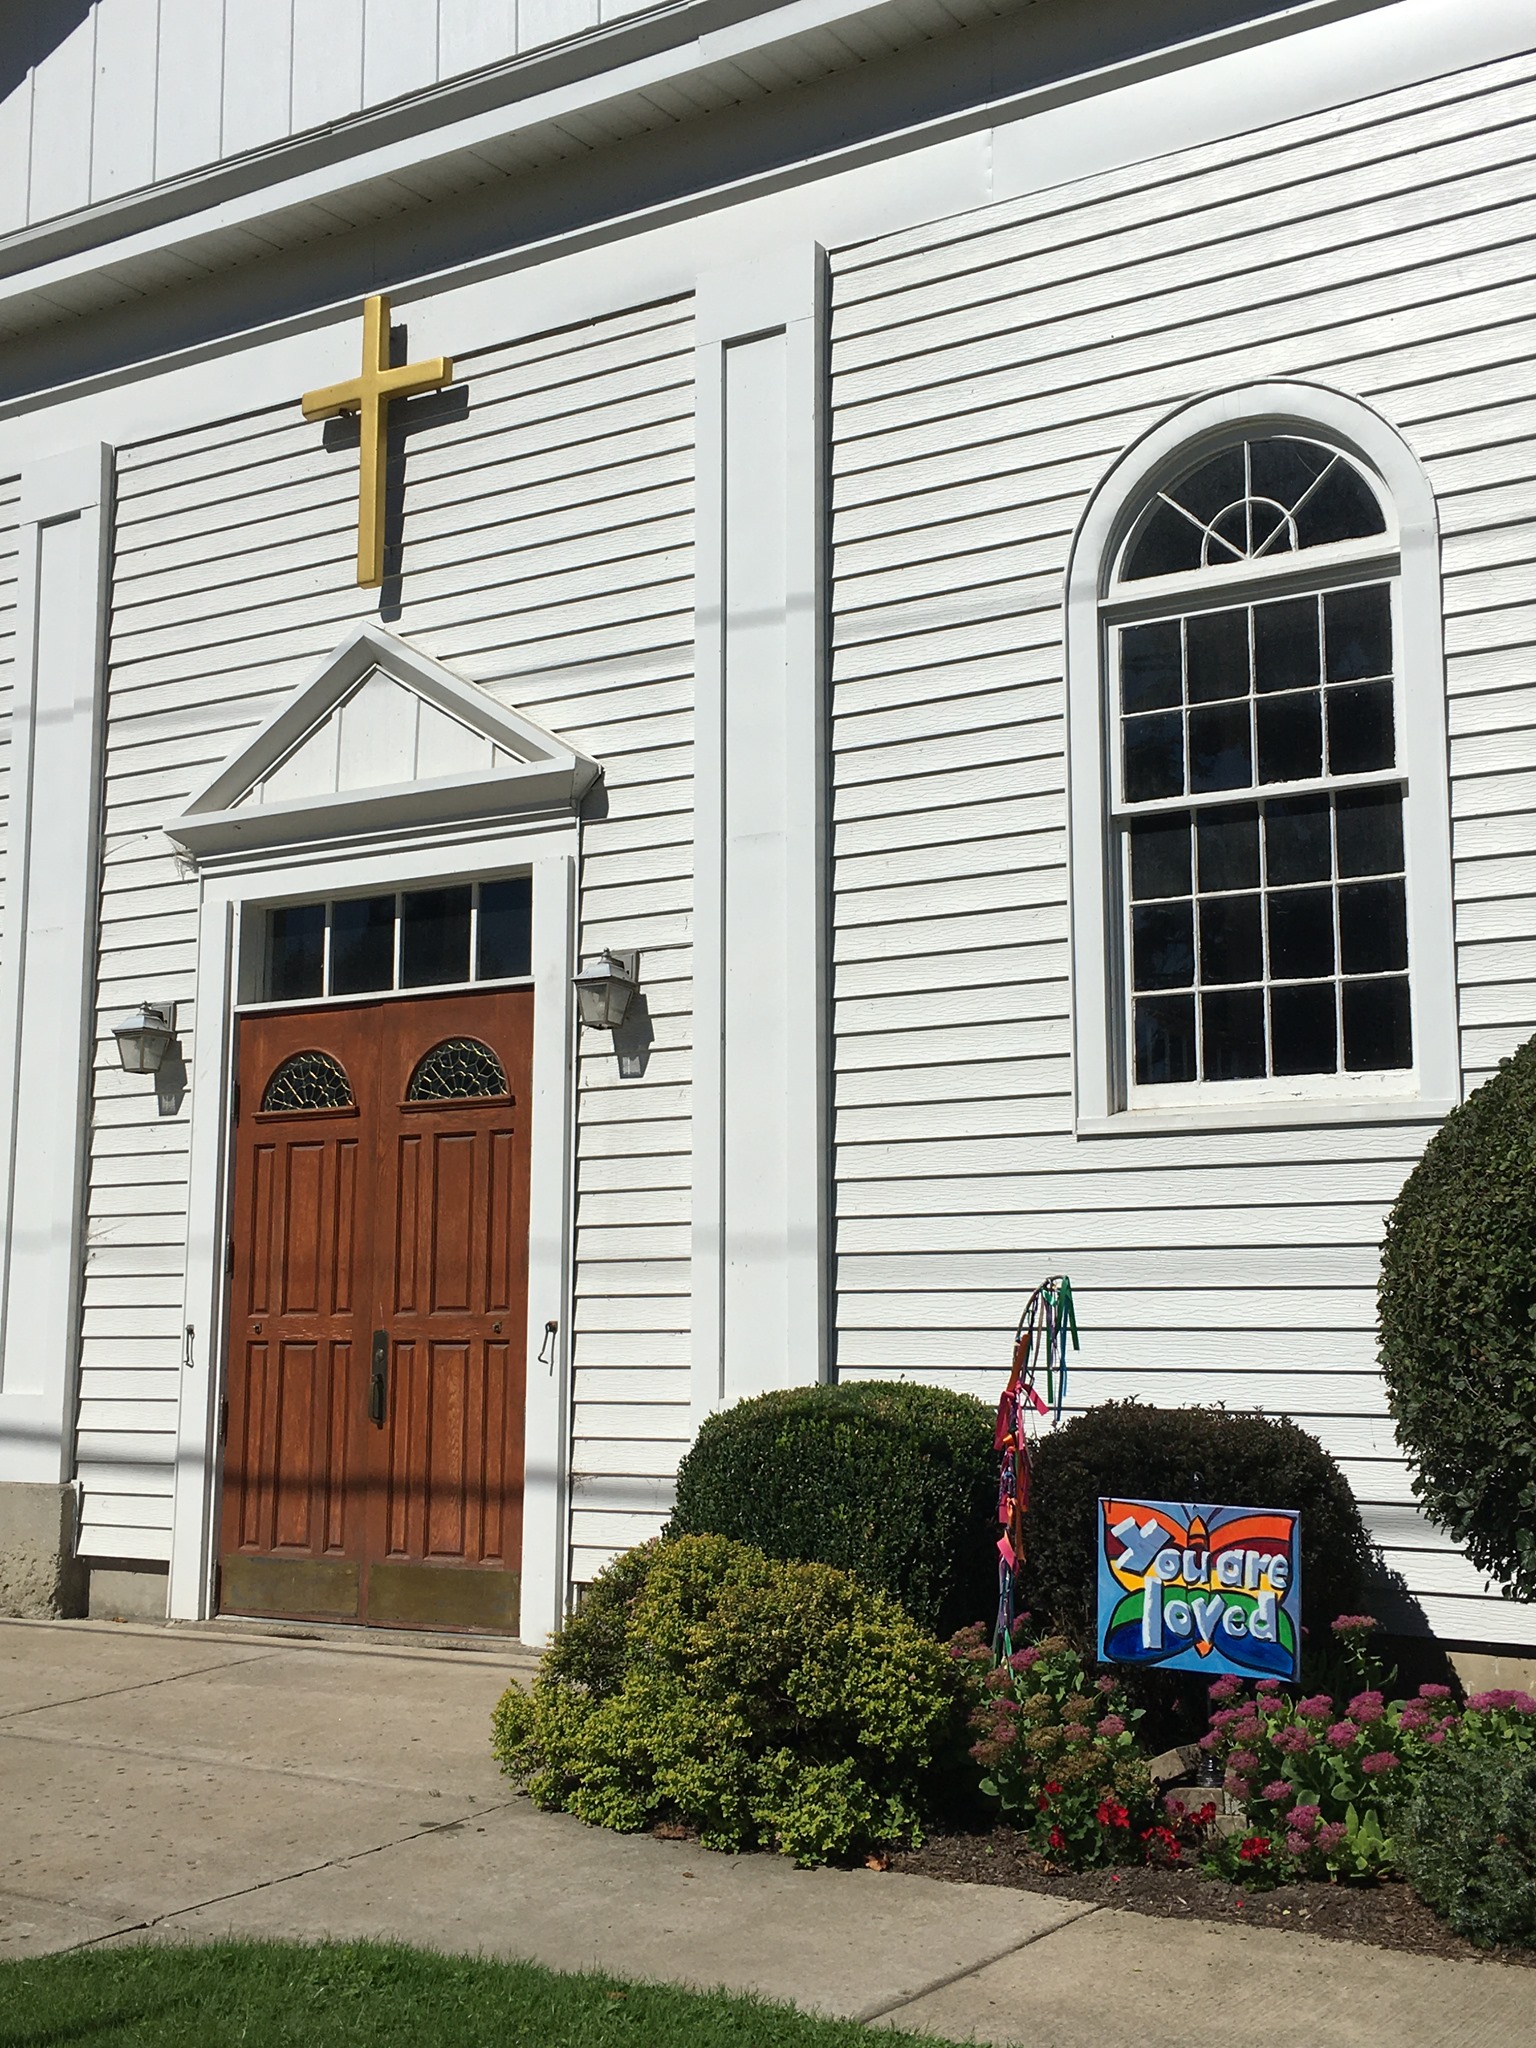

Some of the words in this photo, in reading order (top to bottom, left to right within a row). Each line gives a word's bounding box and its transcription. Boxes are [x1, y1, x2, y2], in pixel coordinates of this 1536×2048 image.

[1110, 1516, 1210, 1583] You
[1216, 1549, 1289, 1589] are
[1141, 1576, 1278, 1649] loved
